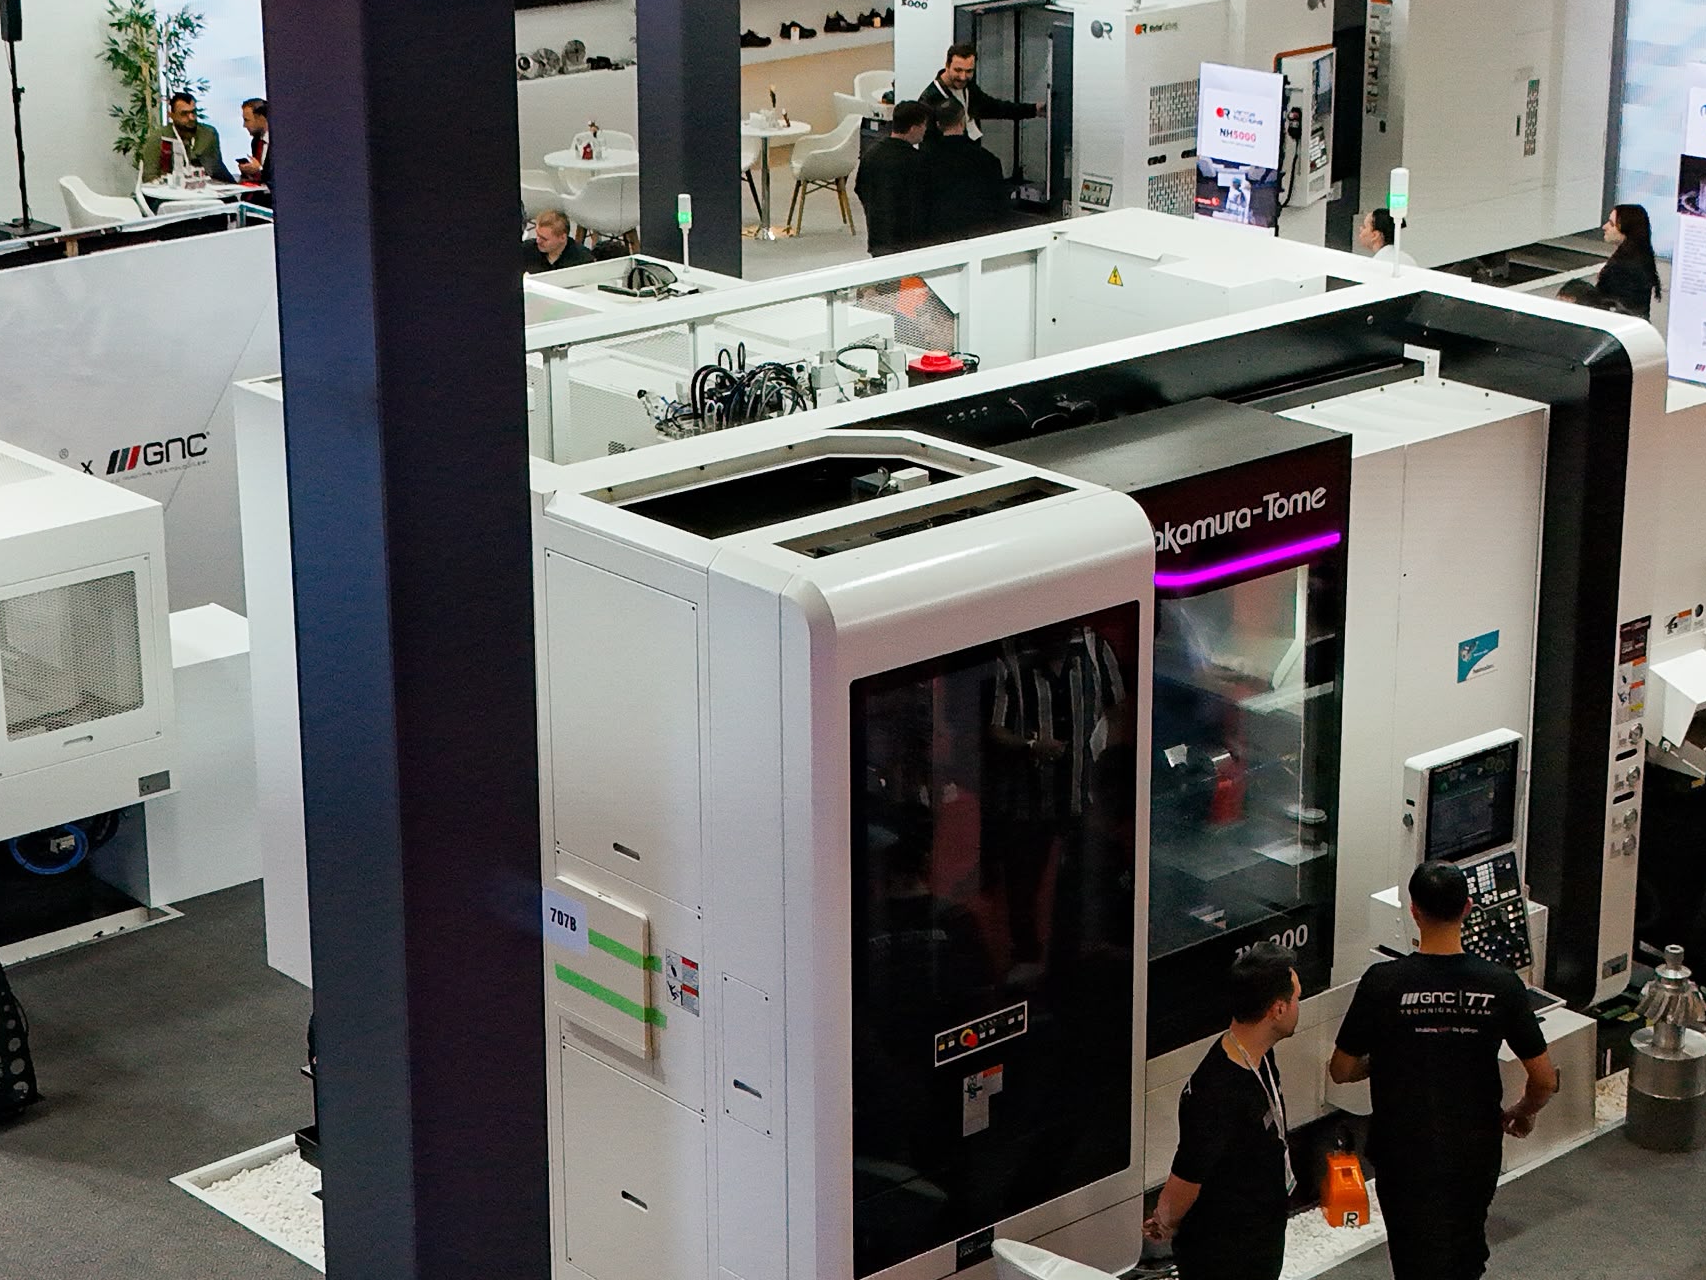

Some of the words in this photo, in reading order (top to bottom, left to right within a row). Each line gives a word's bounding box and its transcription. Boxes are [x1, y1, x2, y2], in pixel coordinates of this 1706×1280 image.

[1155, 486, 1327, 555] akamura-Tome
[550, 907, 577, 932] 707B
[1465, 992, 1495, 1007] TT
[1346, 1212, 1358, 1227] R
